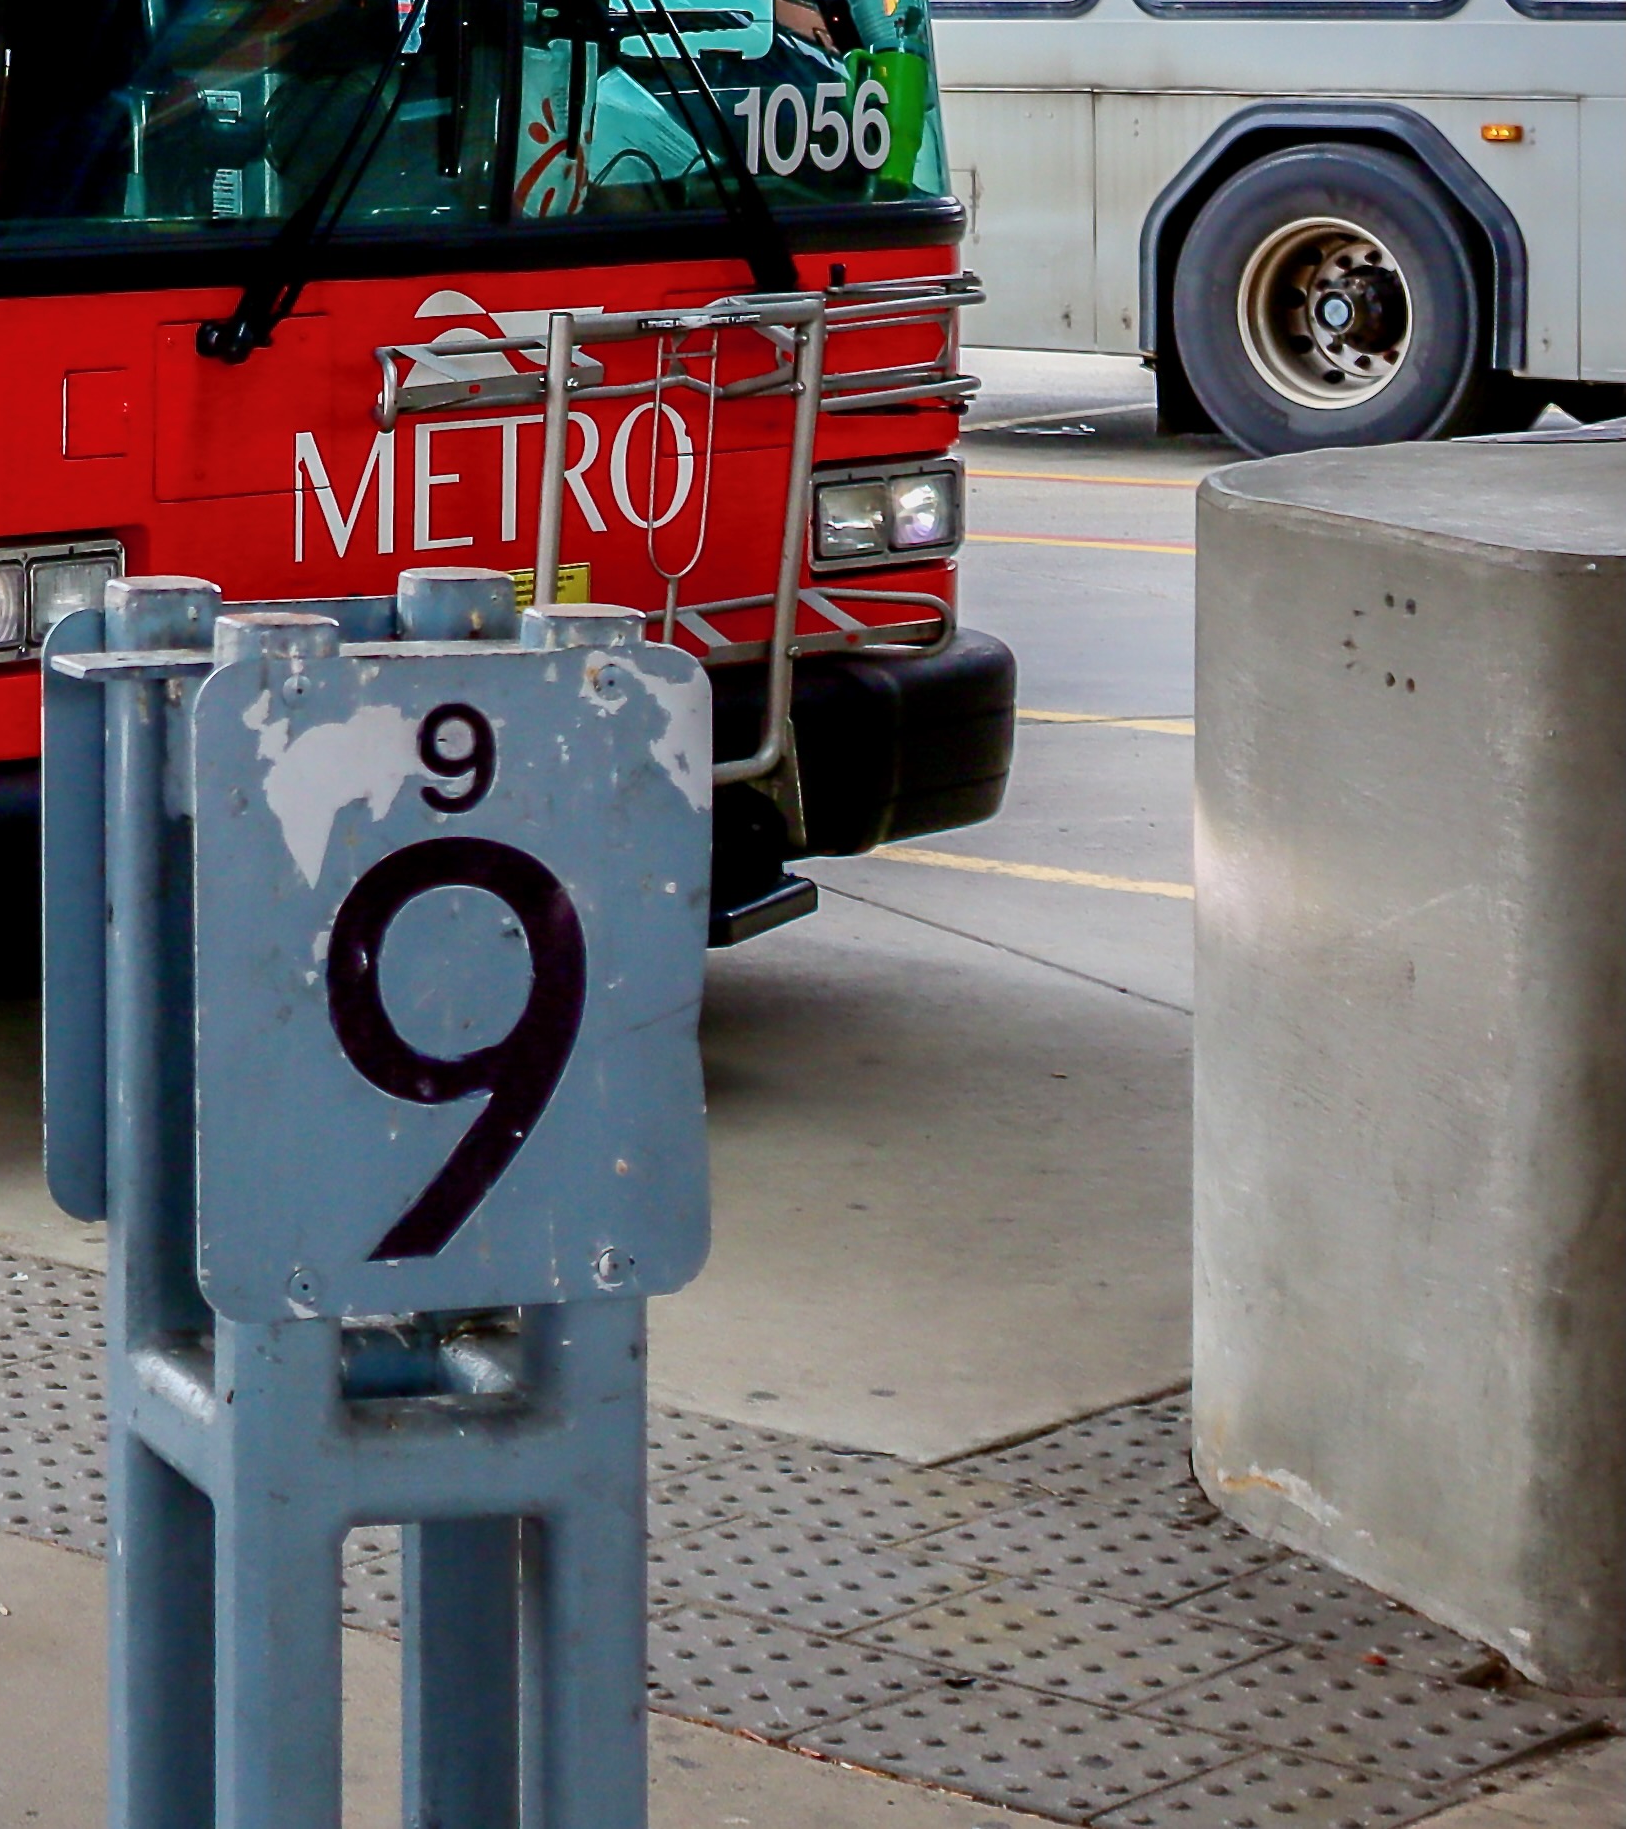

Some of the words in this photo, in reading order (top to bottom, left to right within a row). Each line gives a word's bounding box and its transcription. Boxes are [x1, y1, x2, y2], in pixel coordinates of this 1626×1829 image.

[734, 79, 891, 177] 1056
[294, 401, 695, 563] METRO
[418, 702, 497, 814] 9
[326, 836, 588, 1262] 9
